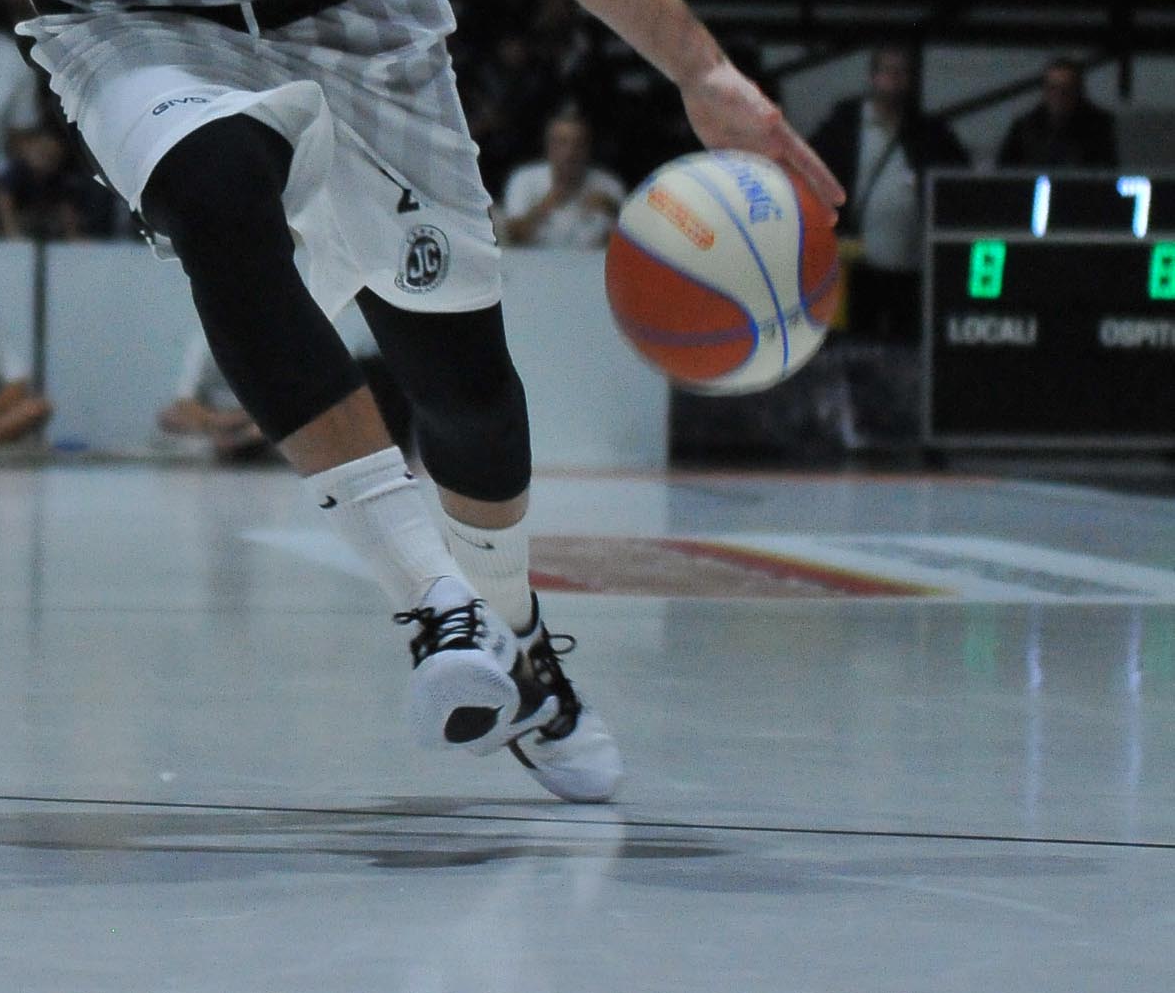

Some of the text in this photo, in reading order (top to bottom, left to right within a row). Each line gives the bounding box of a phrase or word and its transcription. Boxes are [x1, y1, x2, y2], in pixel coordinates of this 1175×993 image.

[152, 97, 210, 116] GIVO
[968, 239, 1007, 298] 8
[948, 315, 1038, 346] LOCALI
